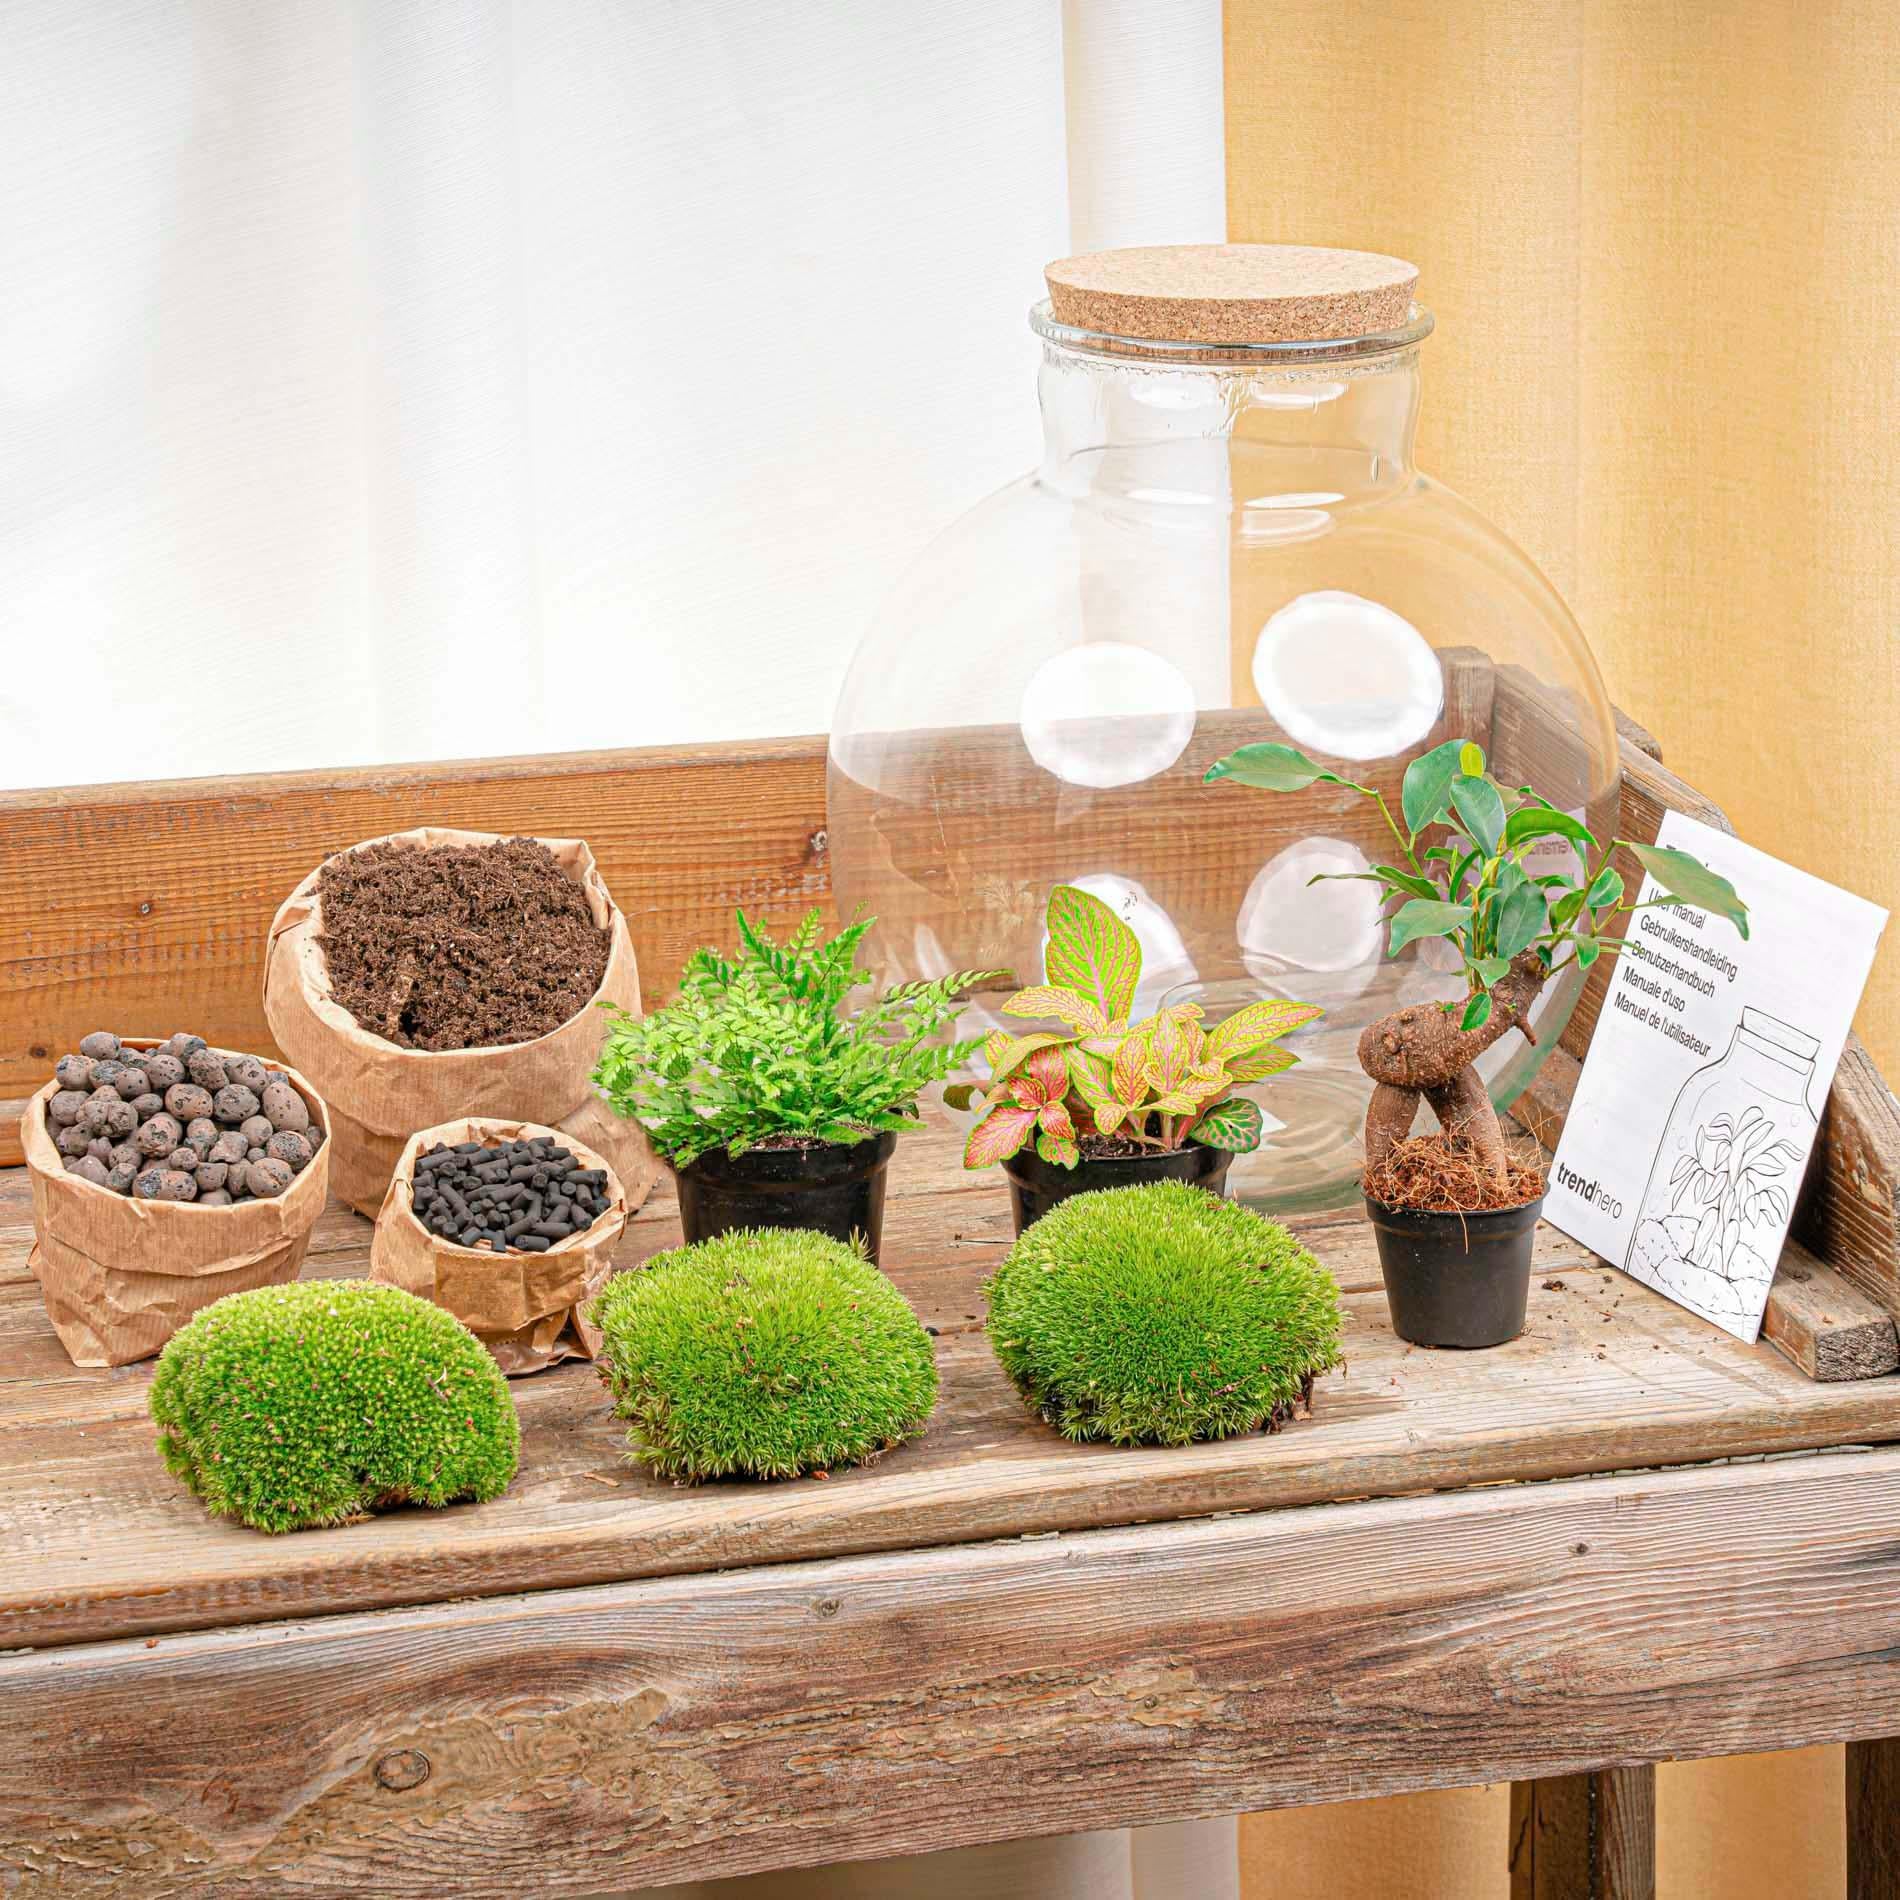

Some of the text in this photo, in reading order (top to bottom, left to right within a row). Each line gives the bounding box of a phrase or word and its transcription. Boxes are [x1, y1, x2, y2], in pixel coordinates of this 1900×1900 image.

[1672, 903, 1706, 929] manual
[1631, 940, 1716, 998] Benutzerhandbuch
[1640, 914, 1738, 983] Gebruikershandleiding
[1614, 991, 1650, 1022] Manuel
[1648, 1010, 1663, 1030] de
[1622, 965, 1686, 1012] Manuale d'uso
[1557, 1162, 1622, 1219] trendhero
